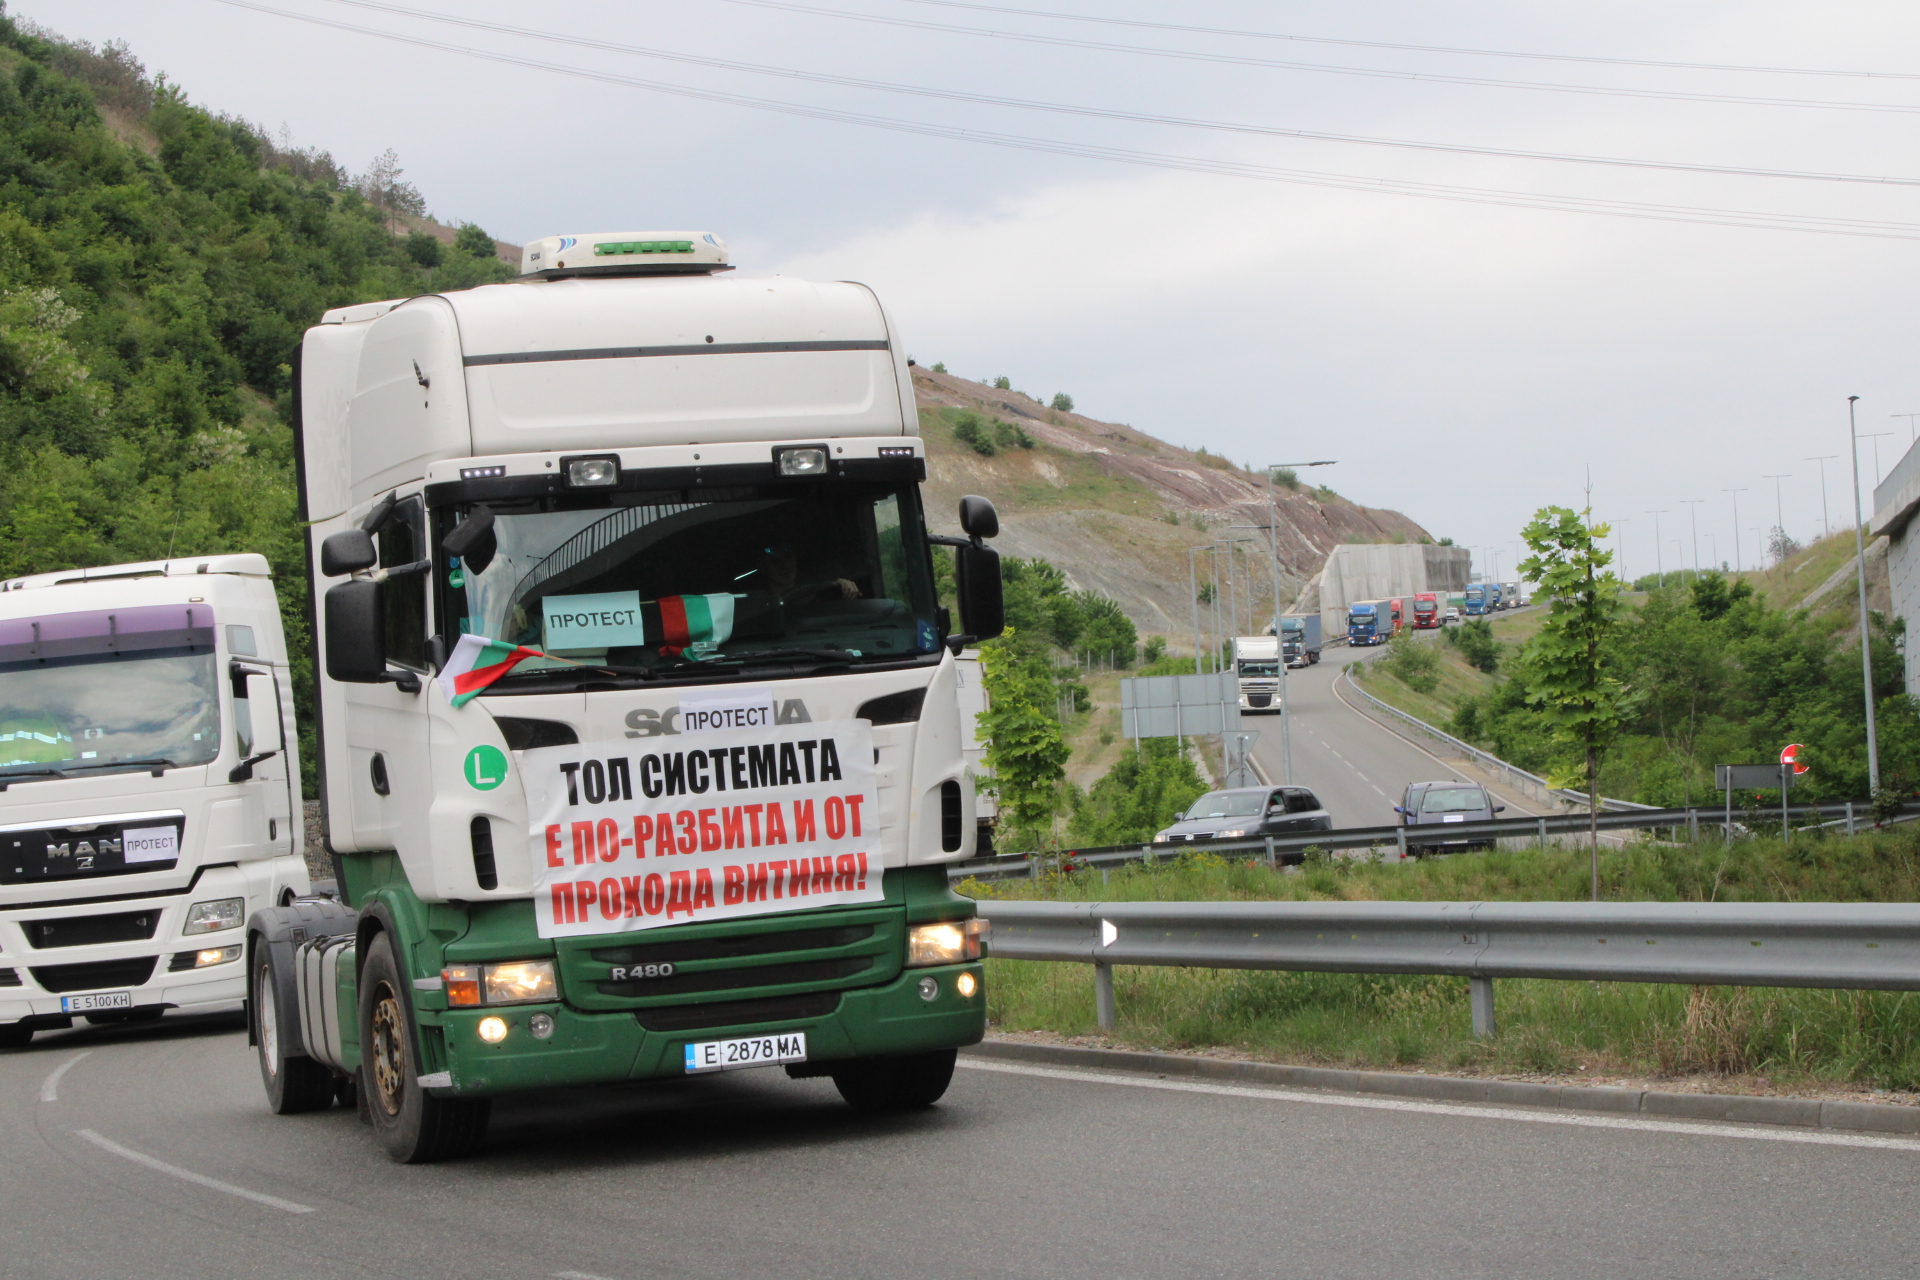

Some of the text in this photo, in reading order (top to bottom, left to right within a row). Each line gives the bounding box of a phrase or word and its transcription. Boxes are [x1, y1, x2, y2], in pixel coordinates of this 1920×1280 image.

[549, 609, 636, 629] ПРОТЕСТ
[685, 706, 769, 731] ПРОТЕСТ
[474, 752, 497, 784] L
[559, 738, 843, 807] ТОЛ СИСТЕМАТА
[544, 793, 864, 868] Е ПО-РАЗБИТА И ОТ
[46, 837, 122, 859] MAN
[127, 837, 175, 852] ПРОТЕСТ
[550, 851, 868, 926] ПРОХОДА ВИТИНЯ!
[629, 963, 673, 979] 480
